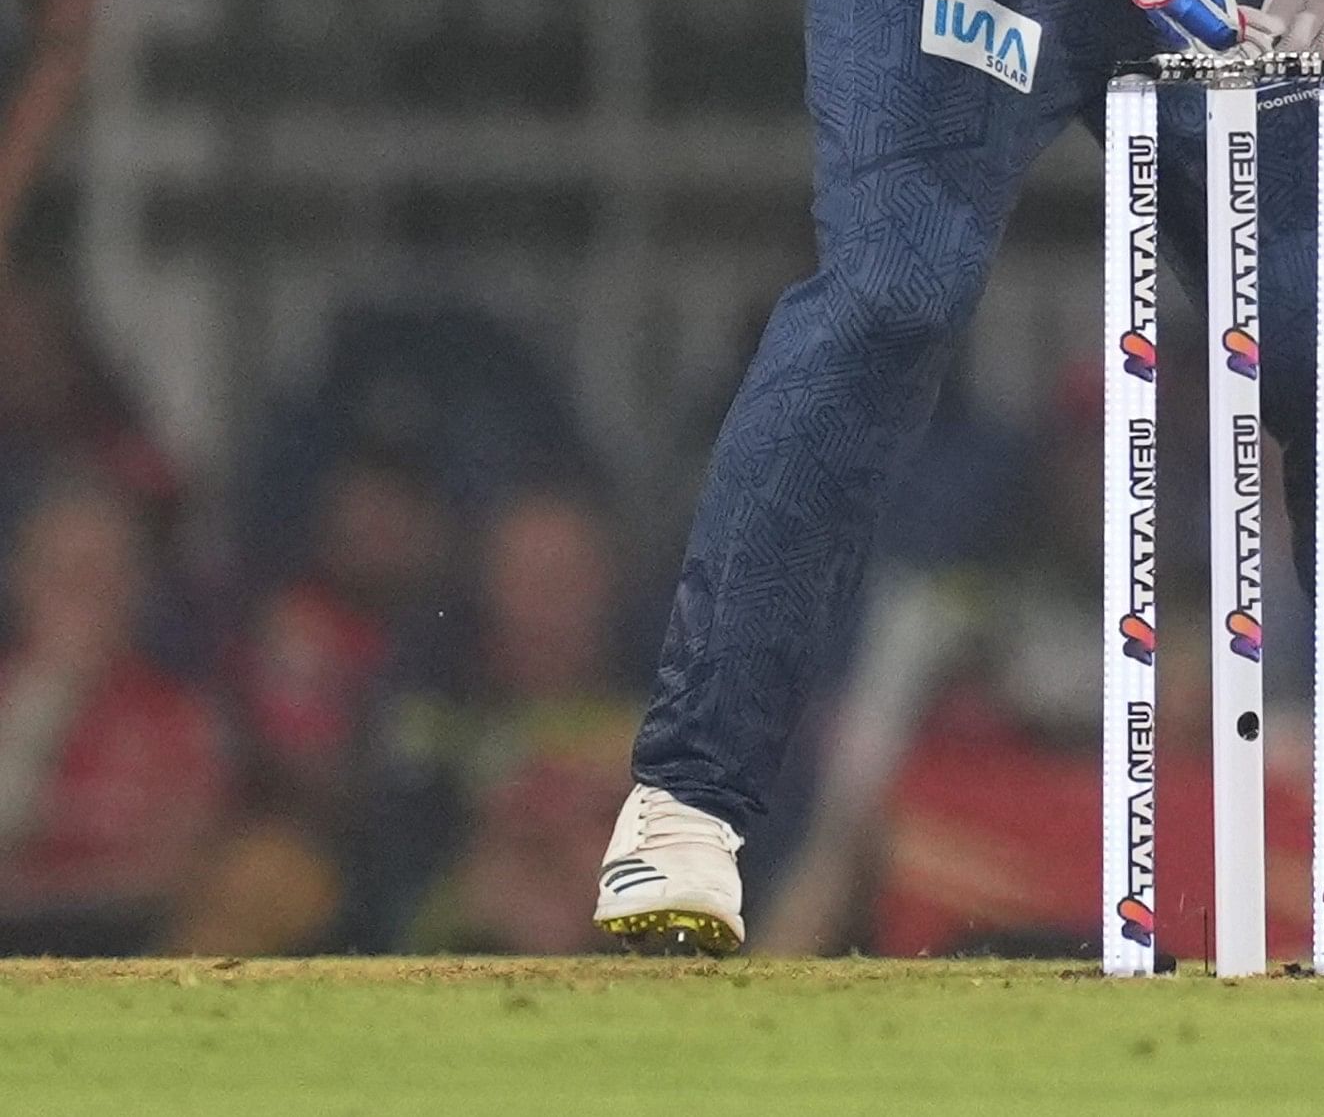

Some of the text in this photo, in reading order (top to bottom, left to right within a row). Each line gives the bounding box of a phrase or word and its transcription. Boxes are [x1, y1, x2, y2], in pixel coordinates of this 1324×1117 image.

[985, 54, 1029, 87] SOLAR
[1128, 135, 1157, 330] TATA NEU
[1228, 131, 1258, 328] TATA NEU
[1129, 417, 1156, 614] TATA NEU
[1232, 414, 1262, 611] TATA NEU
[1127, 701, 1154, 898] TATA NEU
